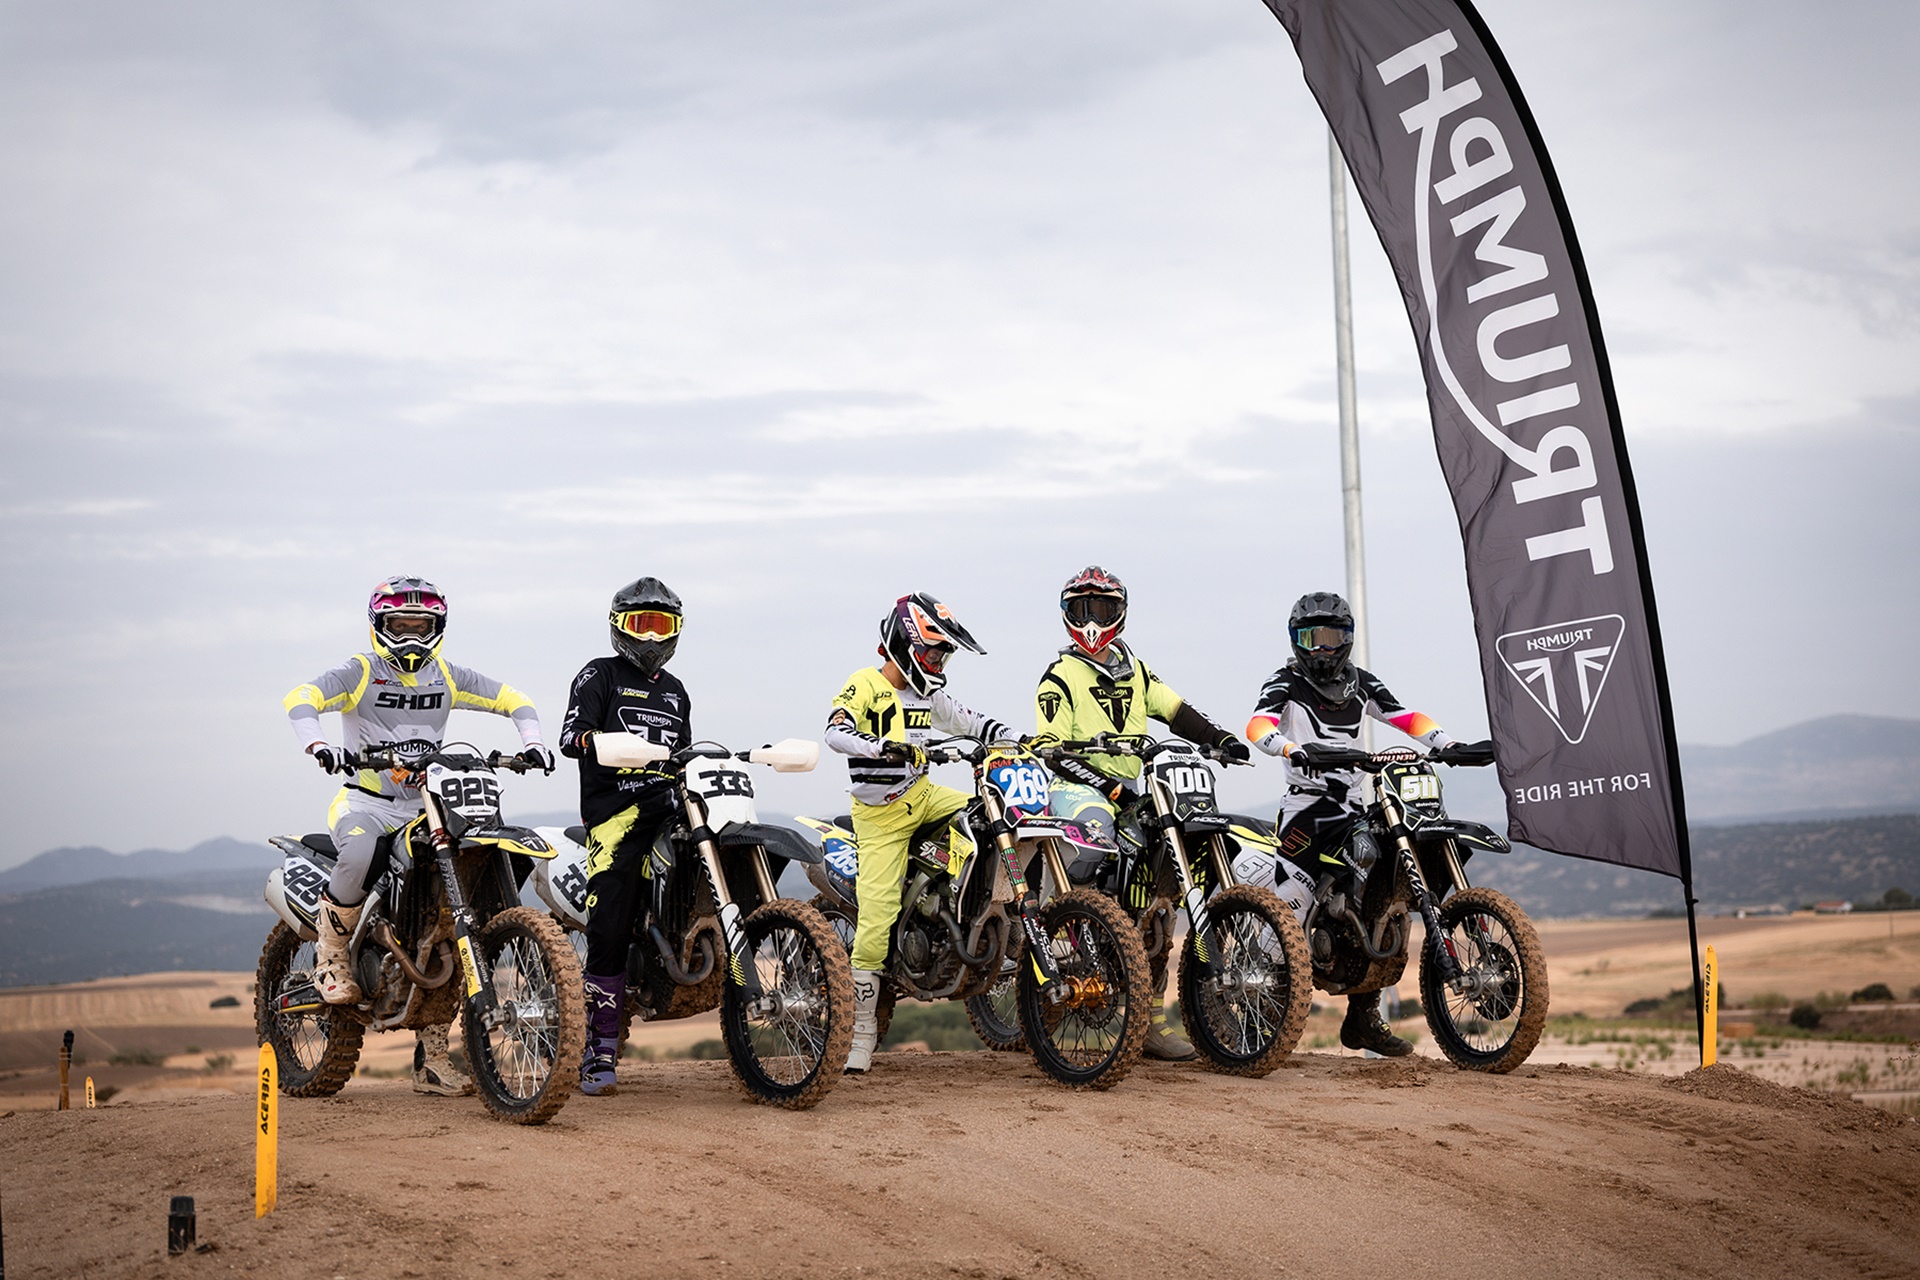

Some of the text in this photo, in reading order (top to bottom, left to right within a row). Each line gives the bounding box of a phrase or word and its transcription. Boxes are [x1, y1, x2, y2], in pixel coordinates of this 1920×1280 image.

[375, 692, 445, 710] SHOT
[636, 713, 671, 727] TRIUMPH
[908, 711, 931, 727] TH
[698, 770, 754, 799] 333
[1061, 759, 1106, 787] UMPH
[1166, 767, 1211, 794] 100
[441, 778, 499, 808] 925
[1000, 768, 1049, 806] 269
[1401, 775, 1439, 802] 511
[284, 864, 330, 907] 925
[1293, 871, 1316, 896] SHO
[260, 1067, 271, 1135] ACERBIS
